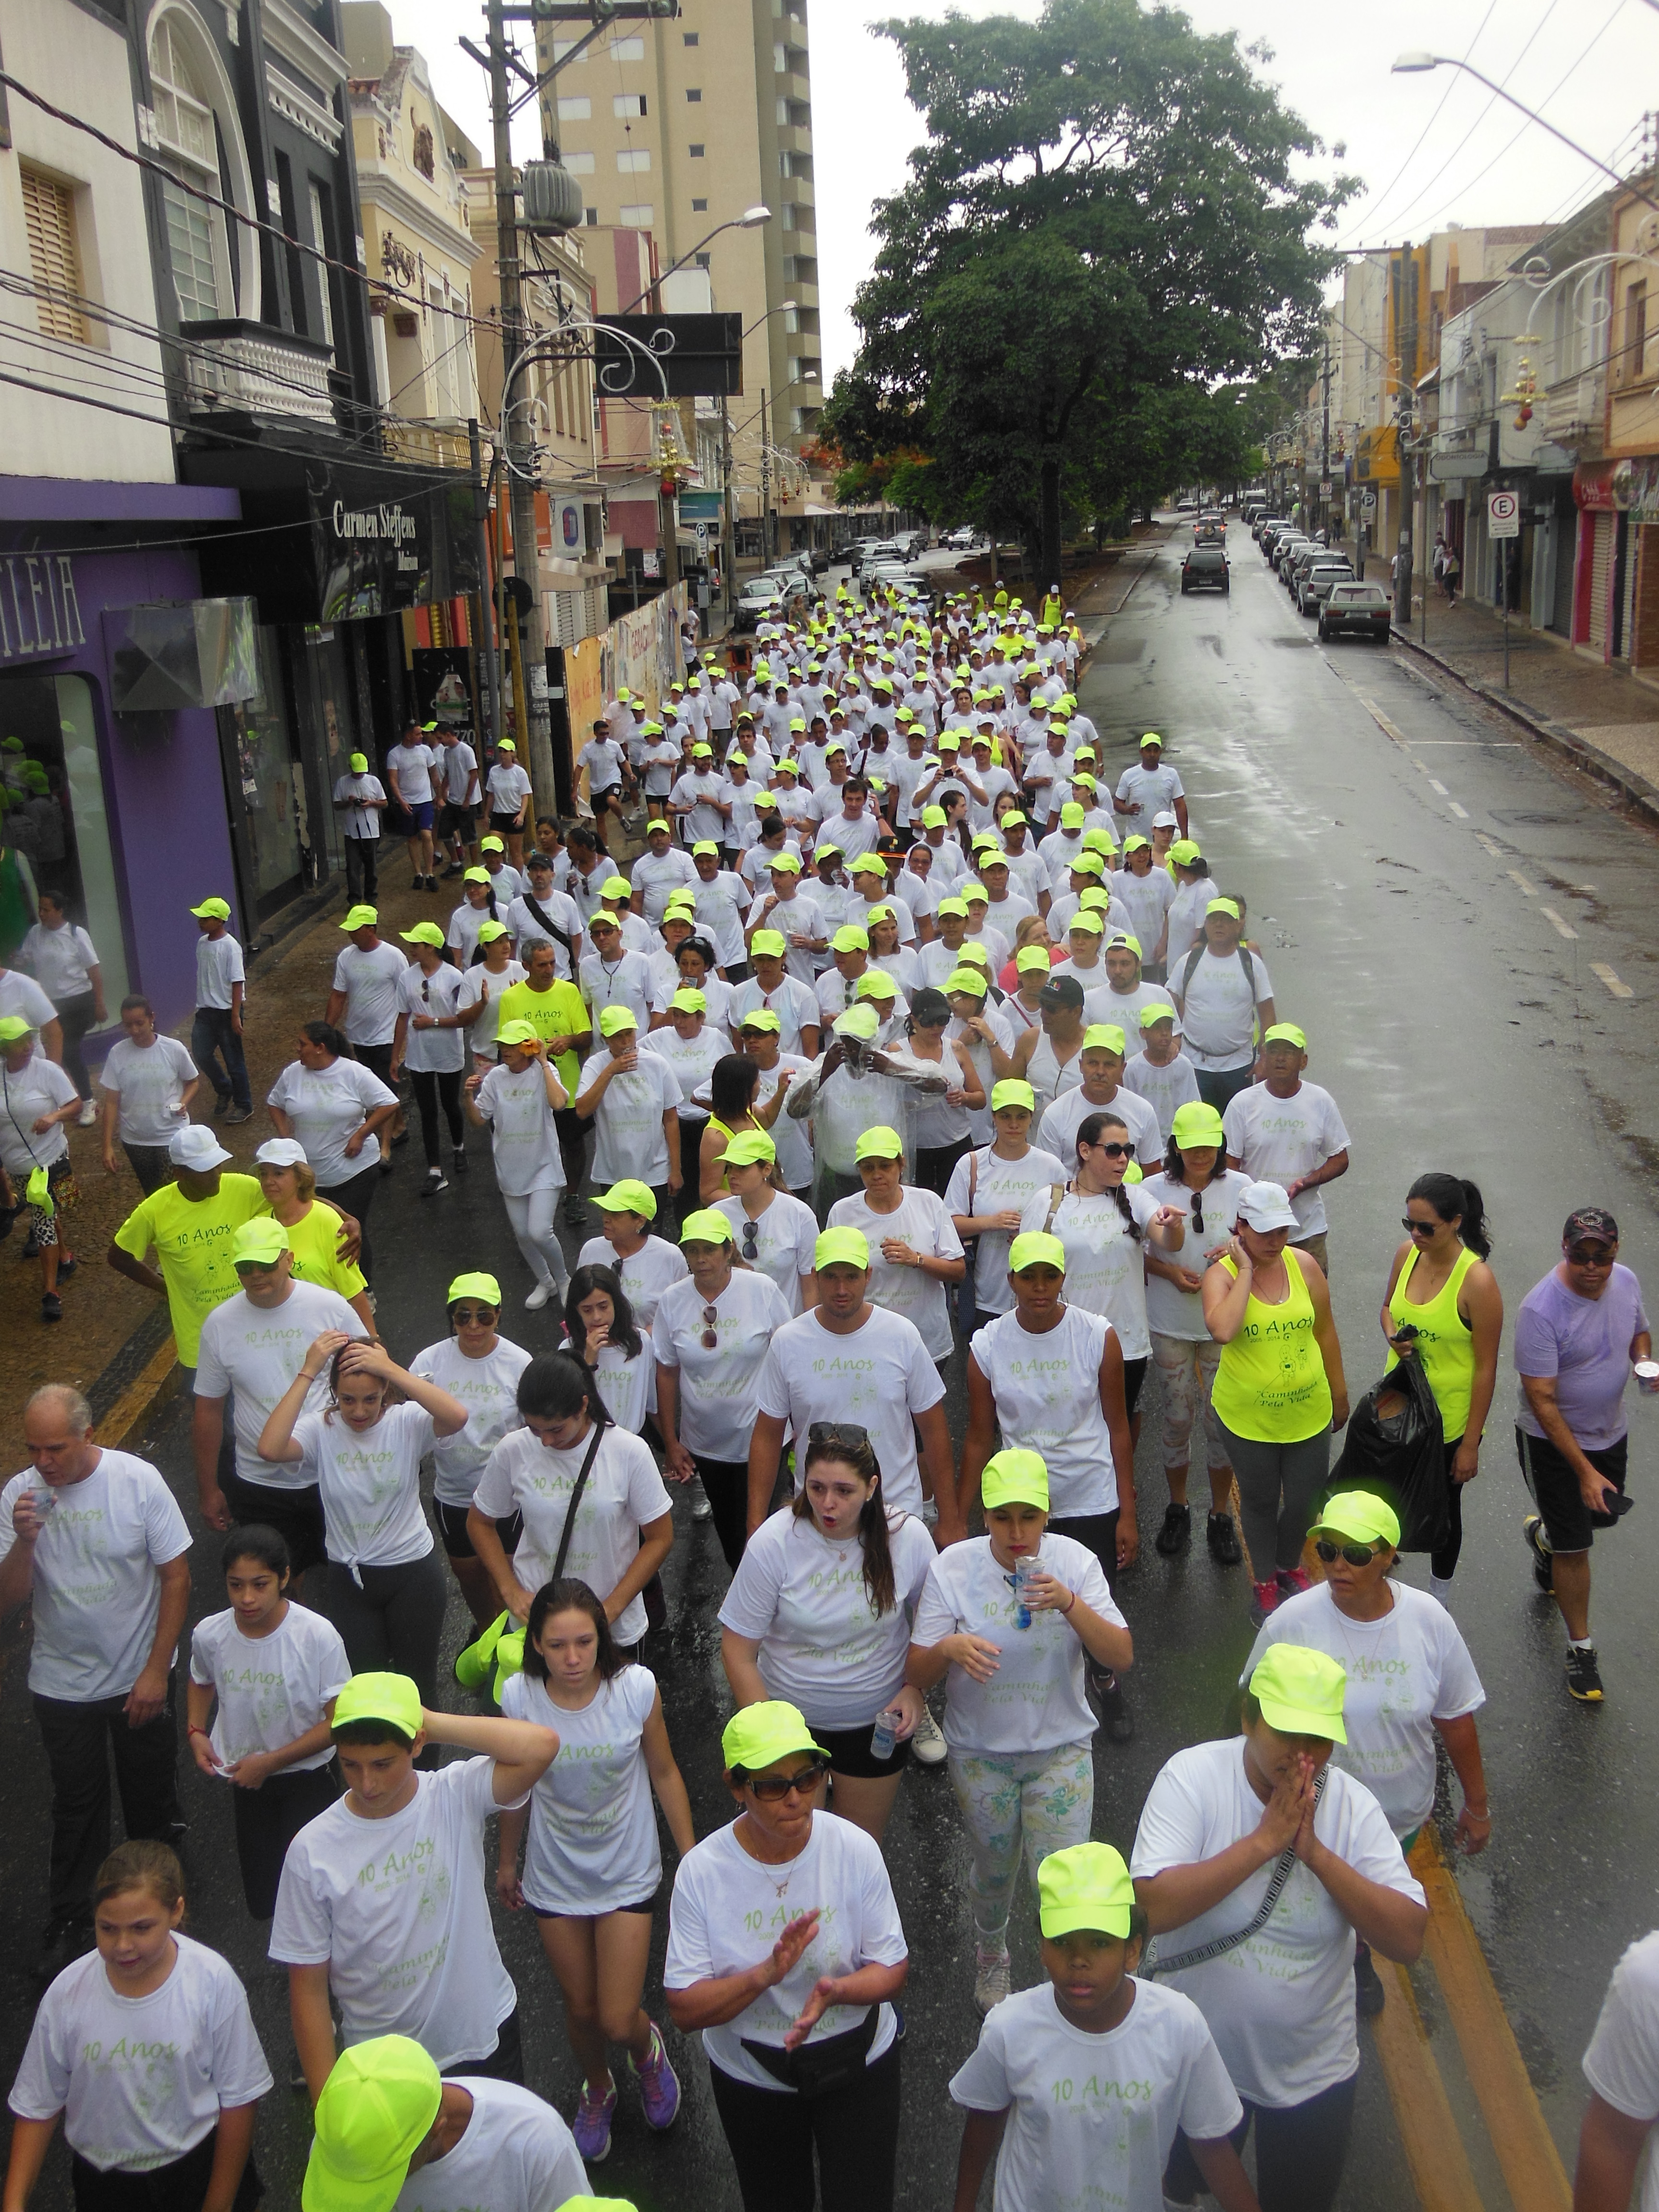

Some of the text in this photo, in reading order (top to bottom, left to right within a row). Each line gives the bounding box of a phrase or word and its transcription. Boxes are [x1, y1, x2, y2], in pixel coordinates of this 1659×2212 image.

[1499, 500, 1507, 514] E
[333, 500, 416, 547] Carmen Steffens
[698, 527, 704, 536] P
[524, 1010, 563, 1021] 10 Anos
[1261, 1118, 1307, 1129] 10 Anos
[991, 1179, 1037, 1190] 10 Anos
[1068, 1217, 1078, 1226] 10
[178, 1224, 232, 1246] 10 Anos
[621, 1277, 645, 1289] nos
[690, 1323, 700, 1334] 10
[1244, 1316, 1312, 1337] 10 Anos
[1397, 1318, 1441, 1342] Aos
[245, 1327, 304, 1344] 10 Anos
[812, 1357, 876, 1373] 10 Anos
[1010, 1358, 1070, 1374] 10 Anos
[598, 1368, 634, 1382] Anos
[448, 1380, 503, 1396] 10 Anos
[1260, 1399, 1284, 1407] Pela
[336, 1451, 395, 1465] 10 Anos
[533, 1477, 547, 1490] 10
[59, 1509, 107, 1523] Anos
[808, 1574, 822, 1589] 10
[983, 1601, 998, 1617] 10
[1352, 1655, 1411, 1675] Anos
[224, 1669, 286, 1686] 10 Anos
[558, 1743, 616, 1761] Anos
[358, 1837, 434, 1887] 10 Anos
[374, 1881, 389, 1892] 2005
[745, 1910, 762, 1932] 10
[758, 1932, 775, 1940] 2005
[83, 2037, 180, 2061] 10 Anos
[1051, 2075, 1154, 2104] 10 Anos
